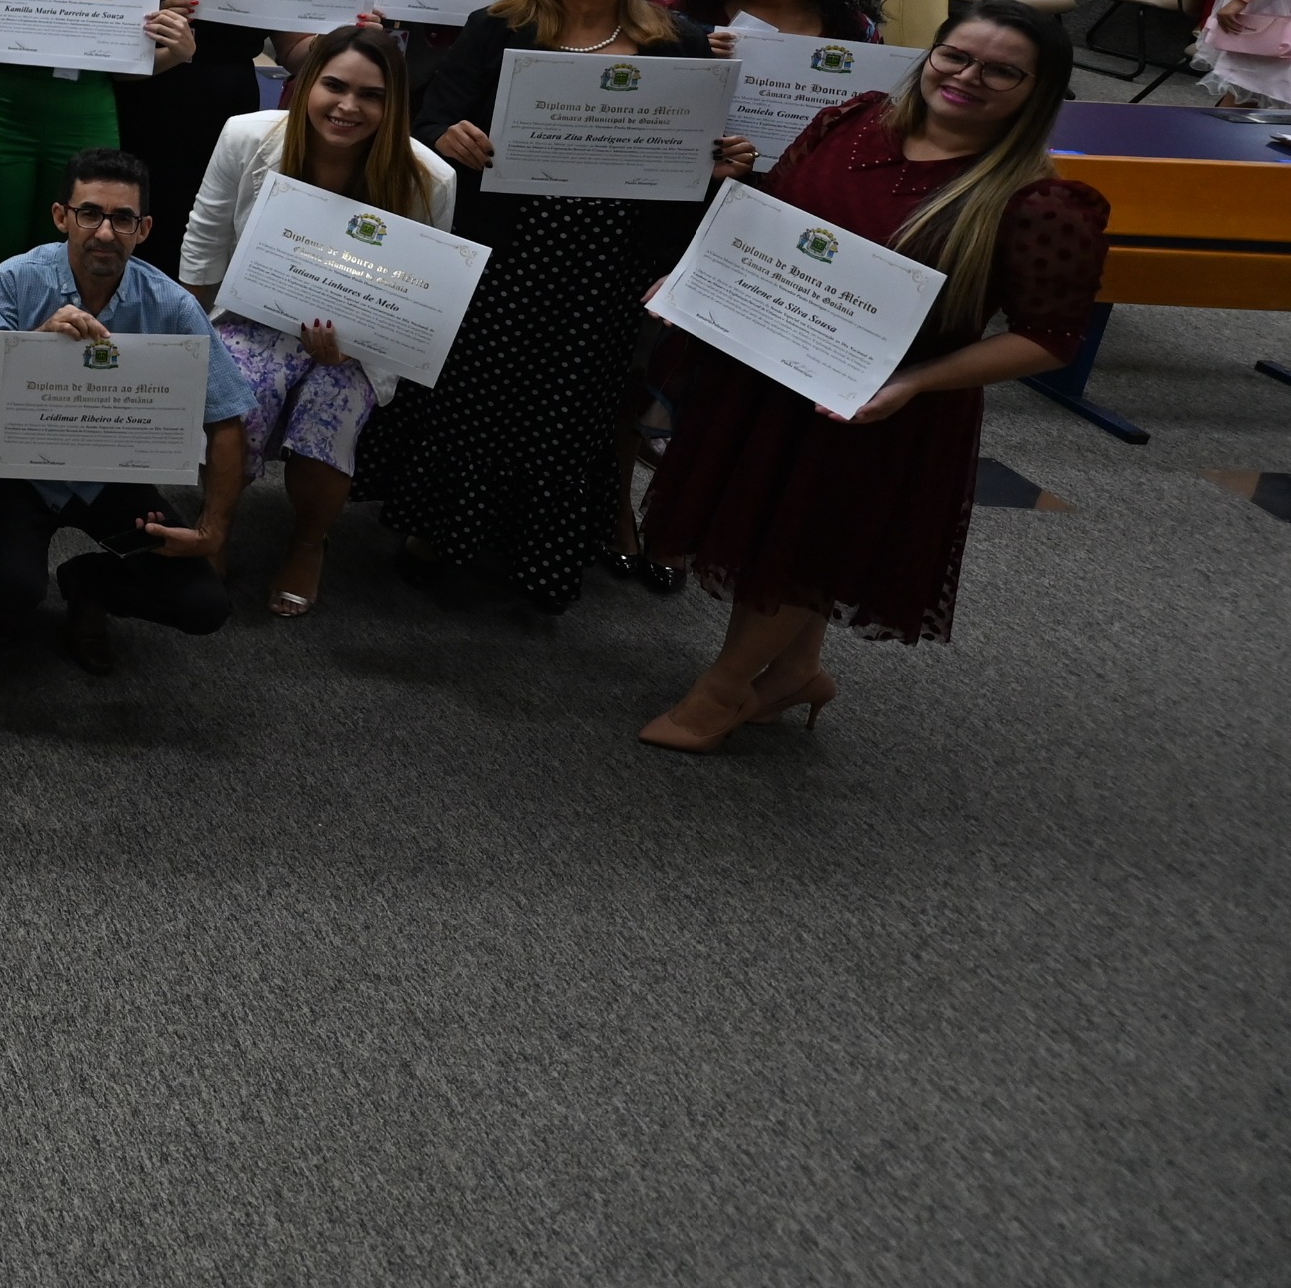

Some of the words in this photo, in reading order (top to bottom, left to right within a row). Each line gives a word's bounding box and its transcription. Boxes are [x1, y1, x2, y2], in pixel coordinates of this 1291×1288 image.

[4, 5, 34, 14] Kamilla
[34, 7, 58, 15] Maria
[58, 8, 90, 18] Parreira
[101, 11, 125, 20] Souza
[737, 105, 775, 117] Daniela
[776, 110, 810, 121] Gomes
[530, 131, 563, 141] Lázara
[563, 133, 583, 142] Zita
[584, 134, 631, 145] Rodrigues
[632, 136, 645, 144] de
[646, 137, 683, 145] Oliveira
[288, 264, 321, 282] Tatiana
[321, 277, 362, 298] Linhares
[362, 293, 375, 303] de
[375, 298, 400, 312] Melo
[731, 237, 774, 264] Diploma
[775, 258, 787, 271] de
[787, 264, 823, 289] Honra
[824, 285, 838, 295] ao
[837, 291, 878, 315] Mérito
[741, 257, 771, 276] Câmara
[770, 272, 812, 296] Municipal
[811, 290, 821, 301] de
[821, 297, 855, 317] Goiânia
[734, 278, 773, 300] Aurilene
[772, 297, 785, 307] da
[784, 302, 809, 319] Silva
[808, 314, 838, 333] Sousa
[39, 413, 79, 422] Leidimar
[80, 414, 112, 423] Ribeiro
[113, 415, 125, 424] de
[125, 416, 152, 425] Souza
